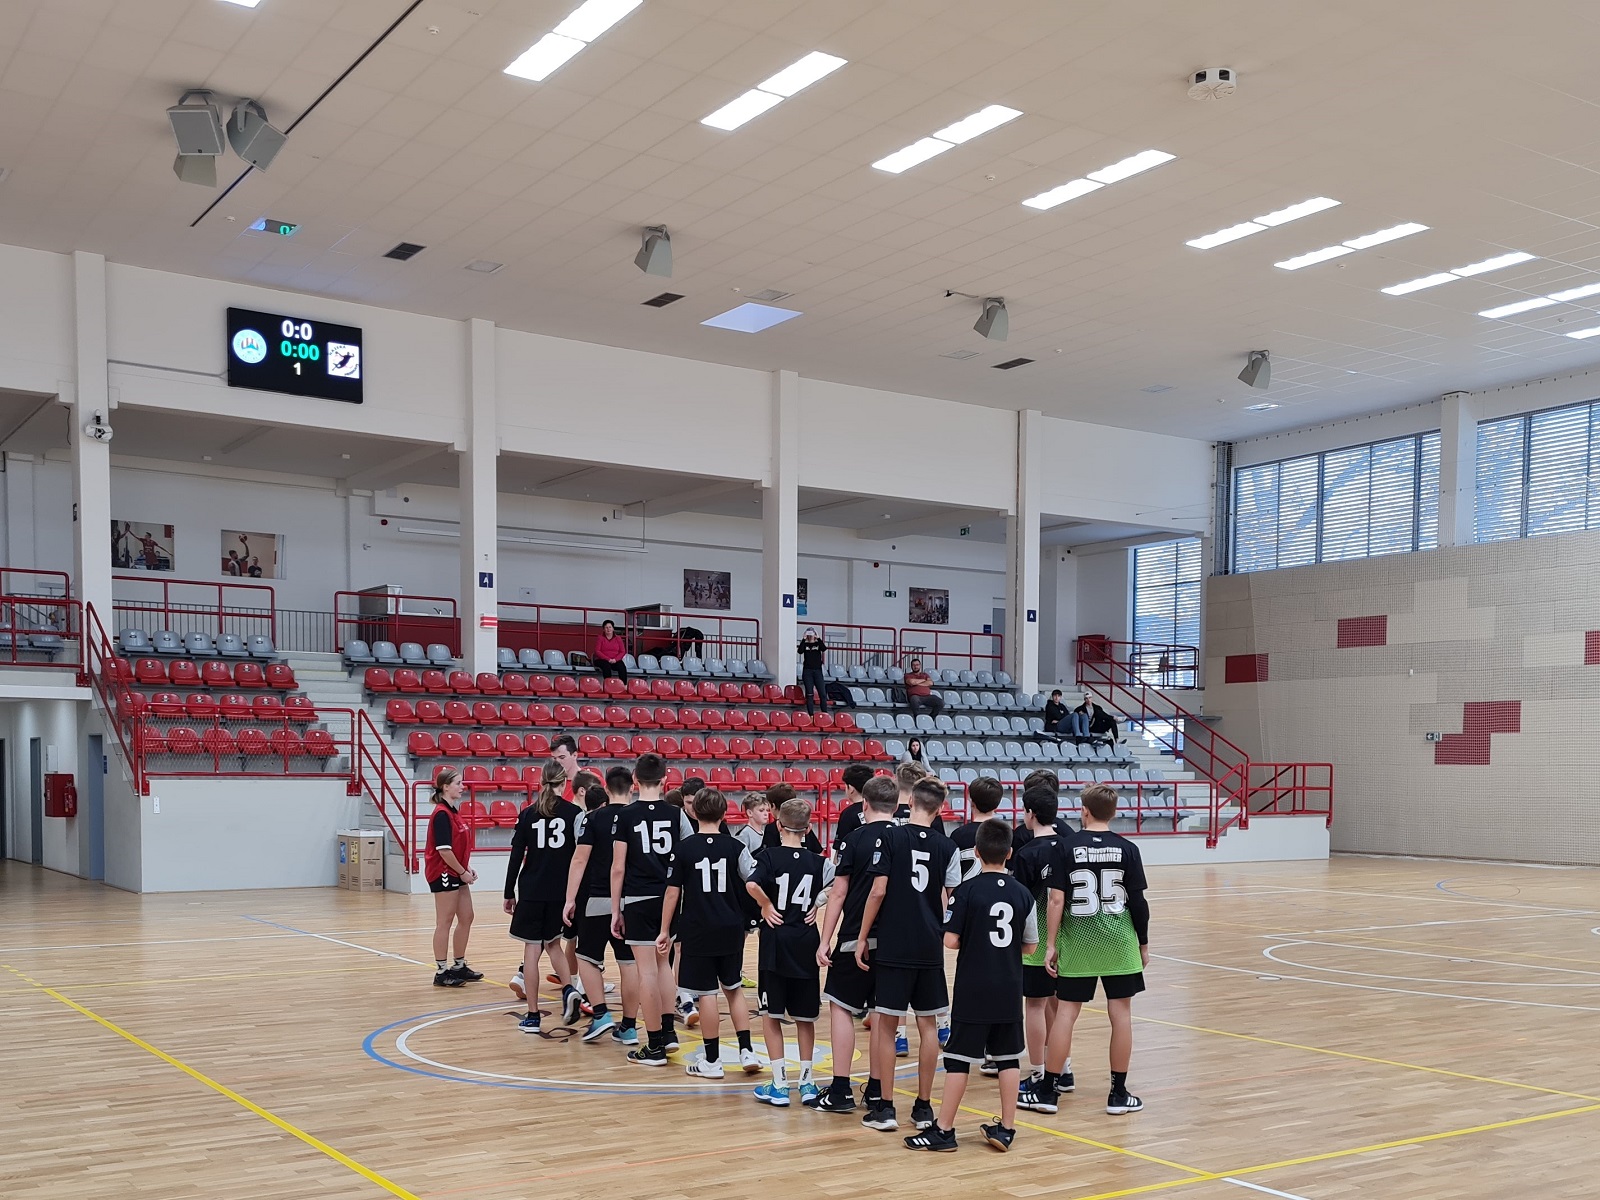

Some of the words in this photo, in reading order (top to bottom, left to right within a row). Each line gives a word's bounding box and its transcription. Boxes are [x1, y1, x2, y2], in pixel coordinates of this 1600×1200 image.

[282, 320, 312, 340] 0:0
[281, 340, 319, 360] 0:00
[293, 362, 301, 375] 1
[531, 817, 566, 848] 13
[633, 820, 672, 854] 15
[695, 857, 727, 893] 11
[911, 850, 930, 892] 5
[1088, 853, 1122, 863] WIMMER
[775, 872, 814, 912] 14
[1069, 869, 1126, 916] 35
[989, 901, 1014, 948] 3
